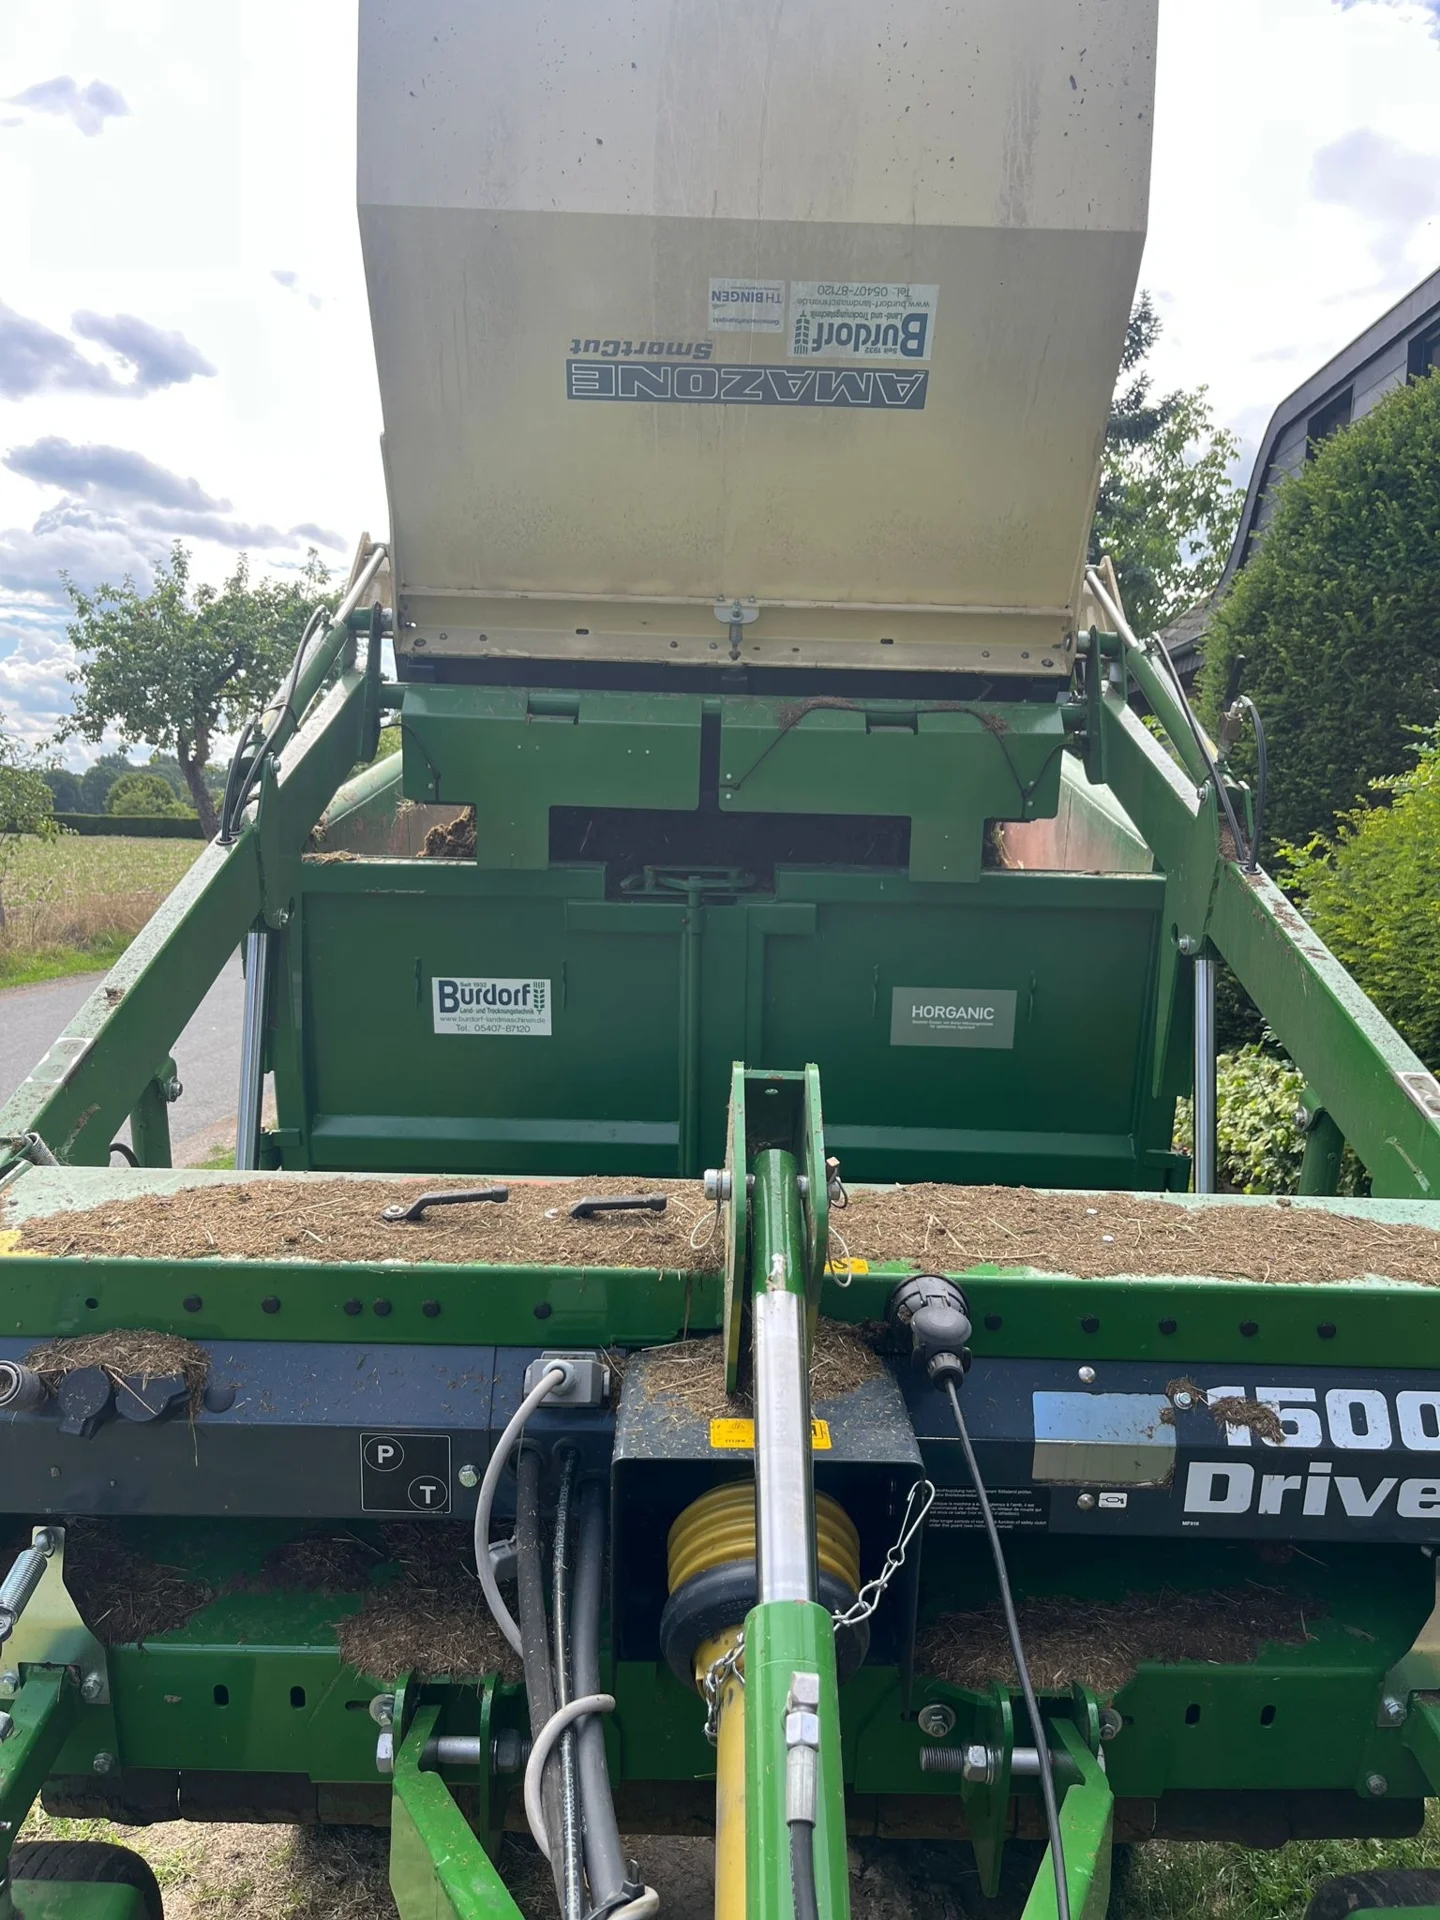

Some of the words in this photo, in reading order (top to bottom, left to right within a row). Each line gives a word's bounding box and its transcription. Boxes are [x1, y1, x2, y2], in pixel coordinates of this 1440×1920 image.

[711, 290, 764, 303] BINGEN
[765, 292, 783, 304] TH
[817, 285, 888, 298] 05407-87120
[797, 298, 930, 310] www.burdorf-landmaschinen.de
[870, 312, 883, 321] und
[811, 313, 929, 357] Burdorf
[569, 339, 713, 360] SmartCut
[572, 363, 925, 404] AMAZONE
[438, 980, 531, 1013] Burdorf
[911, 1005, 995, 1020] HORGANIC
[474, 1024, 531, 1033] 05407-87120
[377, 1445, 394, 1464] P
[419, 1485, 436, 1504] T
[1183, 1461, 1440, 1518] Drive
